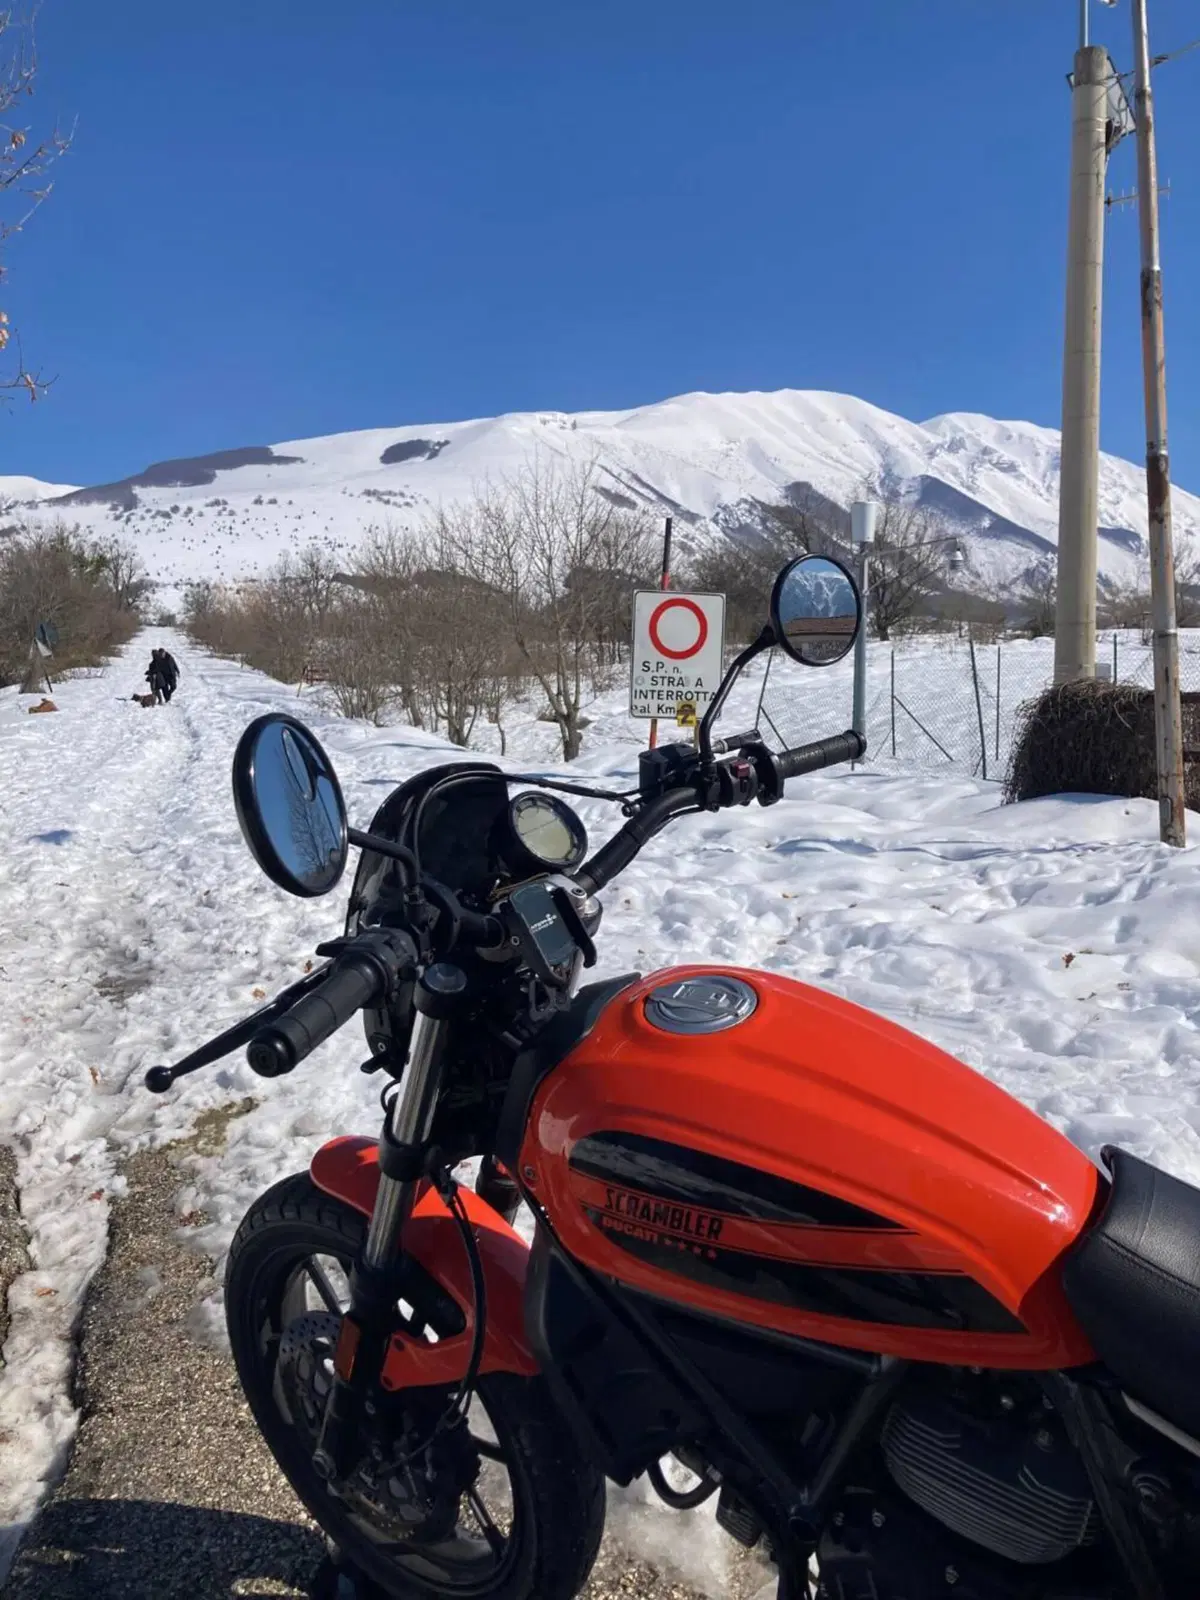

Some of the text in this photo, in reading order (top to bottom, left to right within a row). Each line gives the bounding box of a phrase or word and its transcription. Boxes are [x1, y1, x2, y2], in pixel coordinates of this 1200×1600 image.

[634, 689, 716, 701] INTERROTTA
[605, 1188, 723, 1241] SCRAMBLER
[602, 1217, 658, 1243] DUCATI
